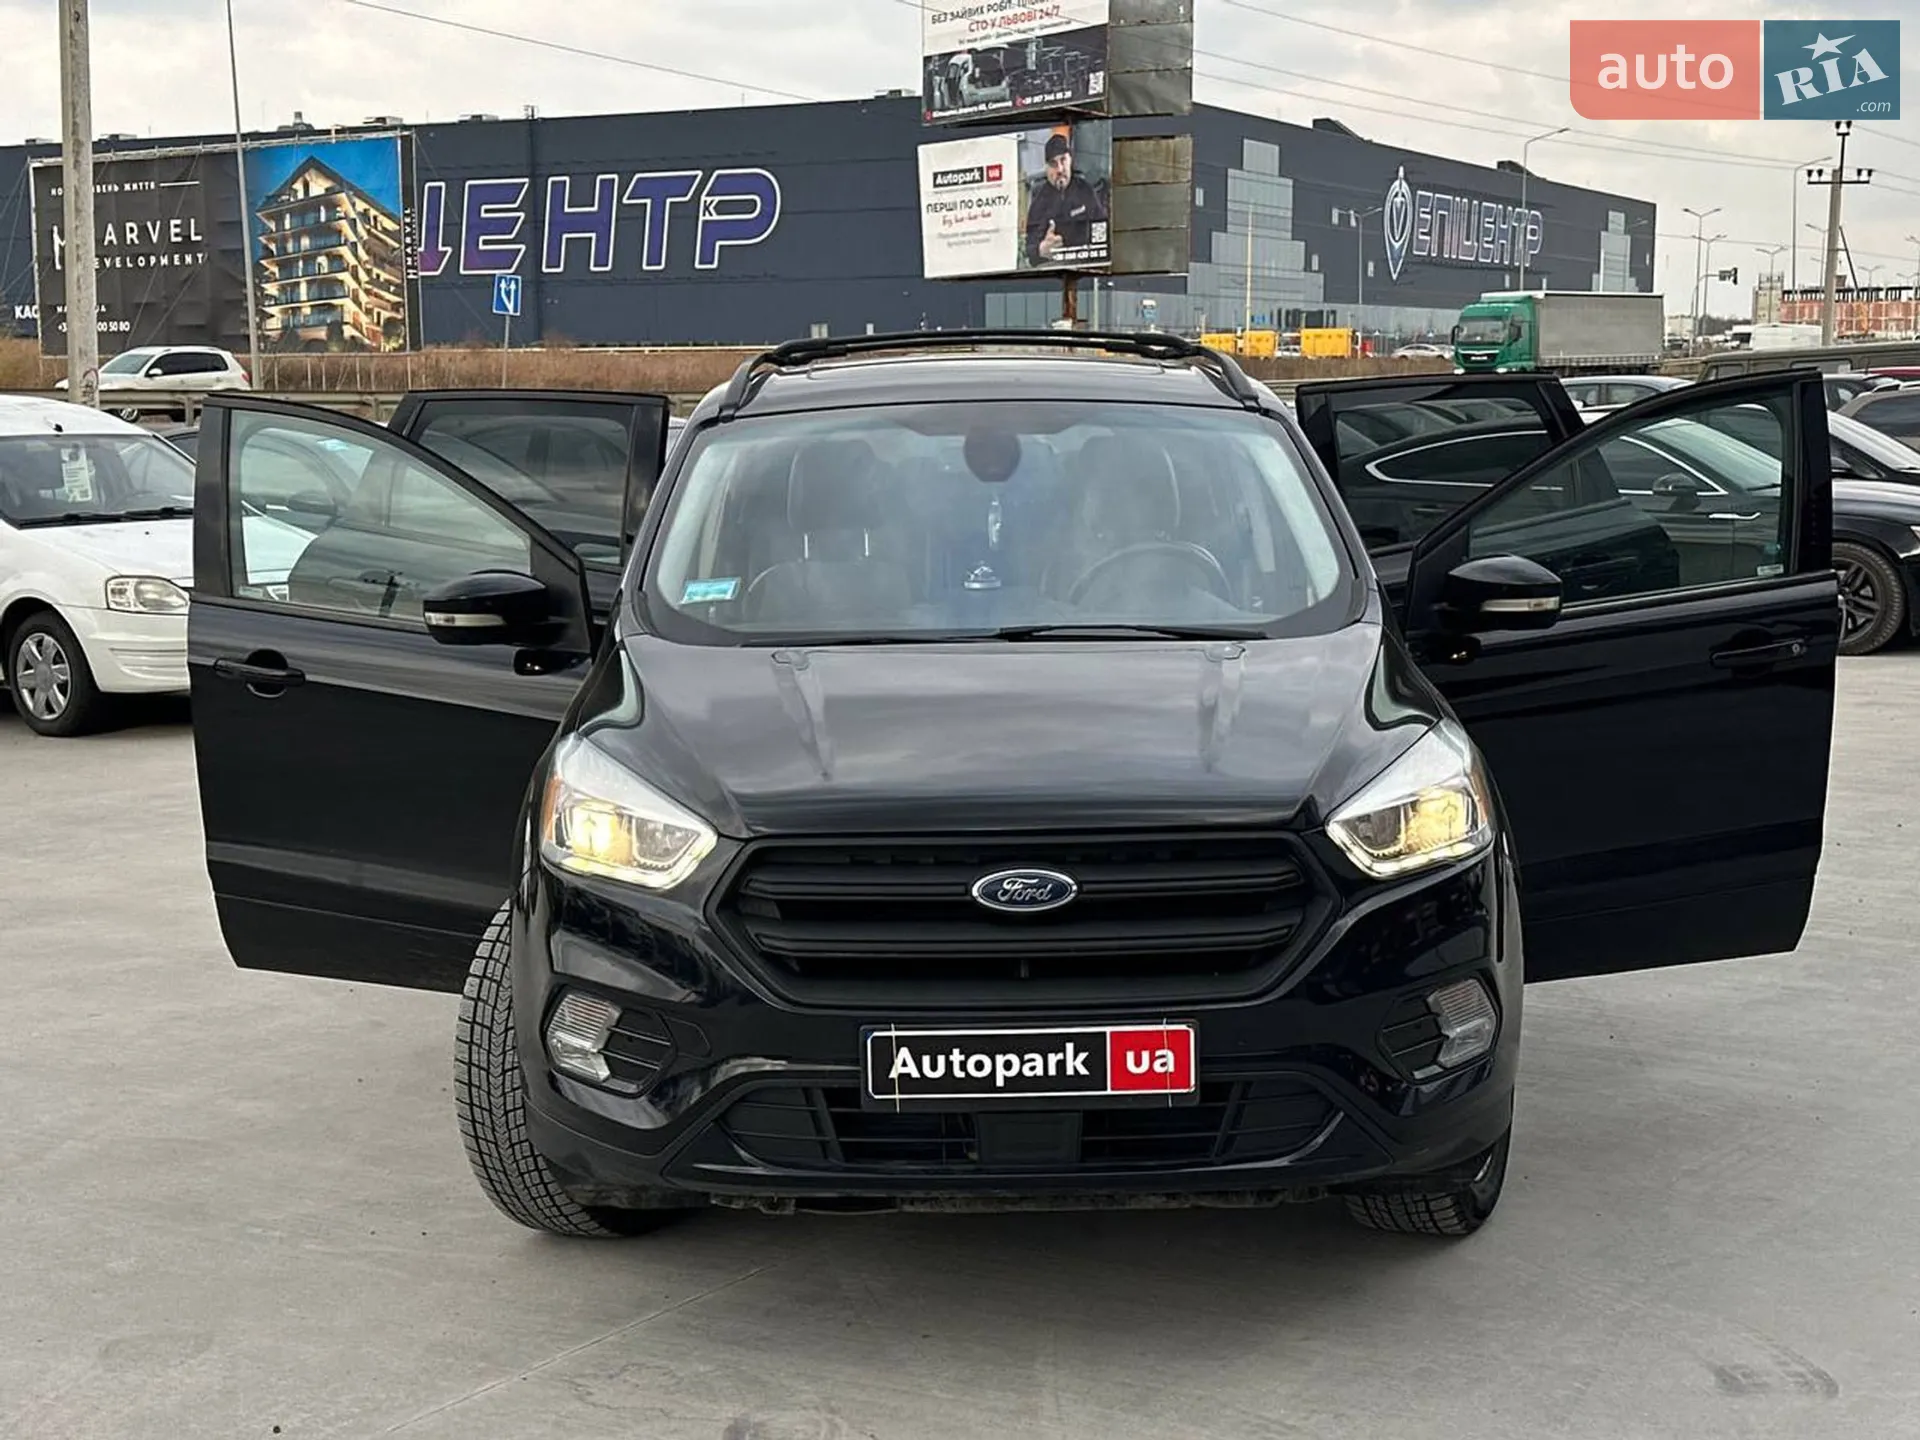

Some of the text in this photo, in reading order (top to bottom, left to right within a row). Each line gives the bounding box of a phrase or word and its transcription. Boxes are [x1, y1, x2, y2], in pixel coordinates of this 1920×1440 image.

[935, 168, 982, 186] Autopark
[926, 199, 958, 214] ПЕРШІ
[959, 199, 975, 211] ПО
[103, 217, 203, 247] ARVEL
[1412, 189, 1545, 268] ЕПІЦЕНТР
[94, 252, 205, 270] EVELOPMENT
[997, 877, 1054, 902] Ford
[888, 1042, 1176, 1087] Autopark ua
